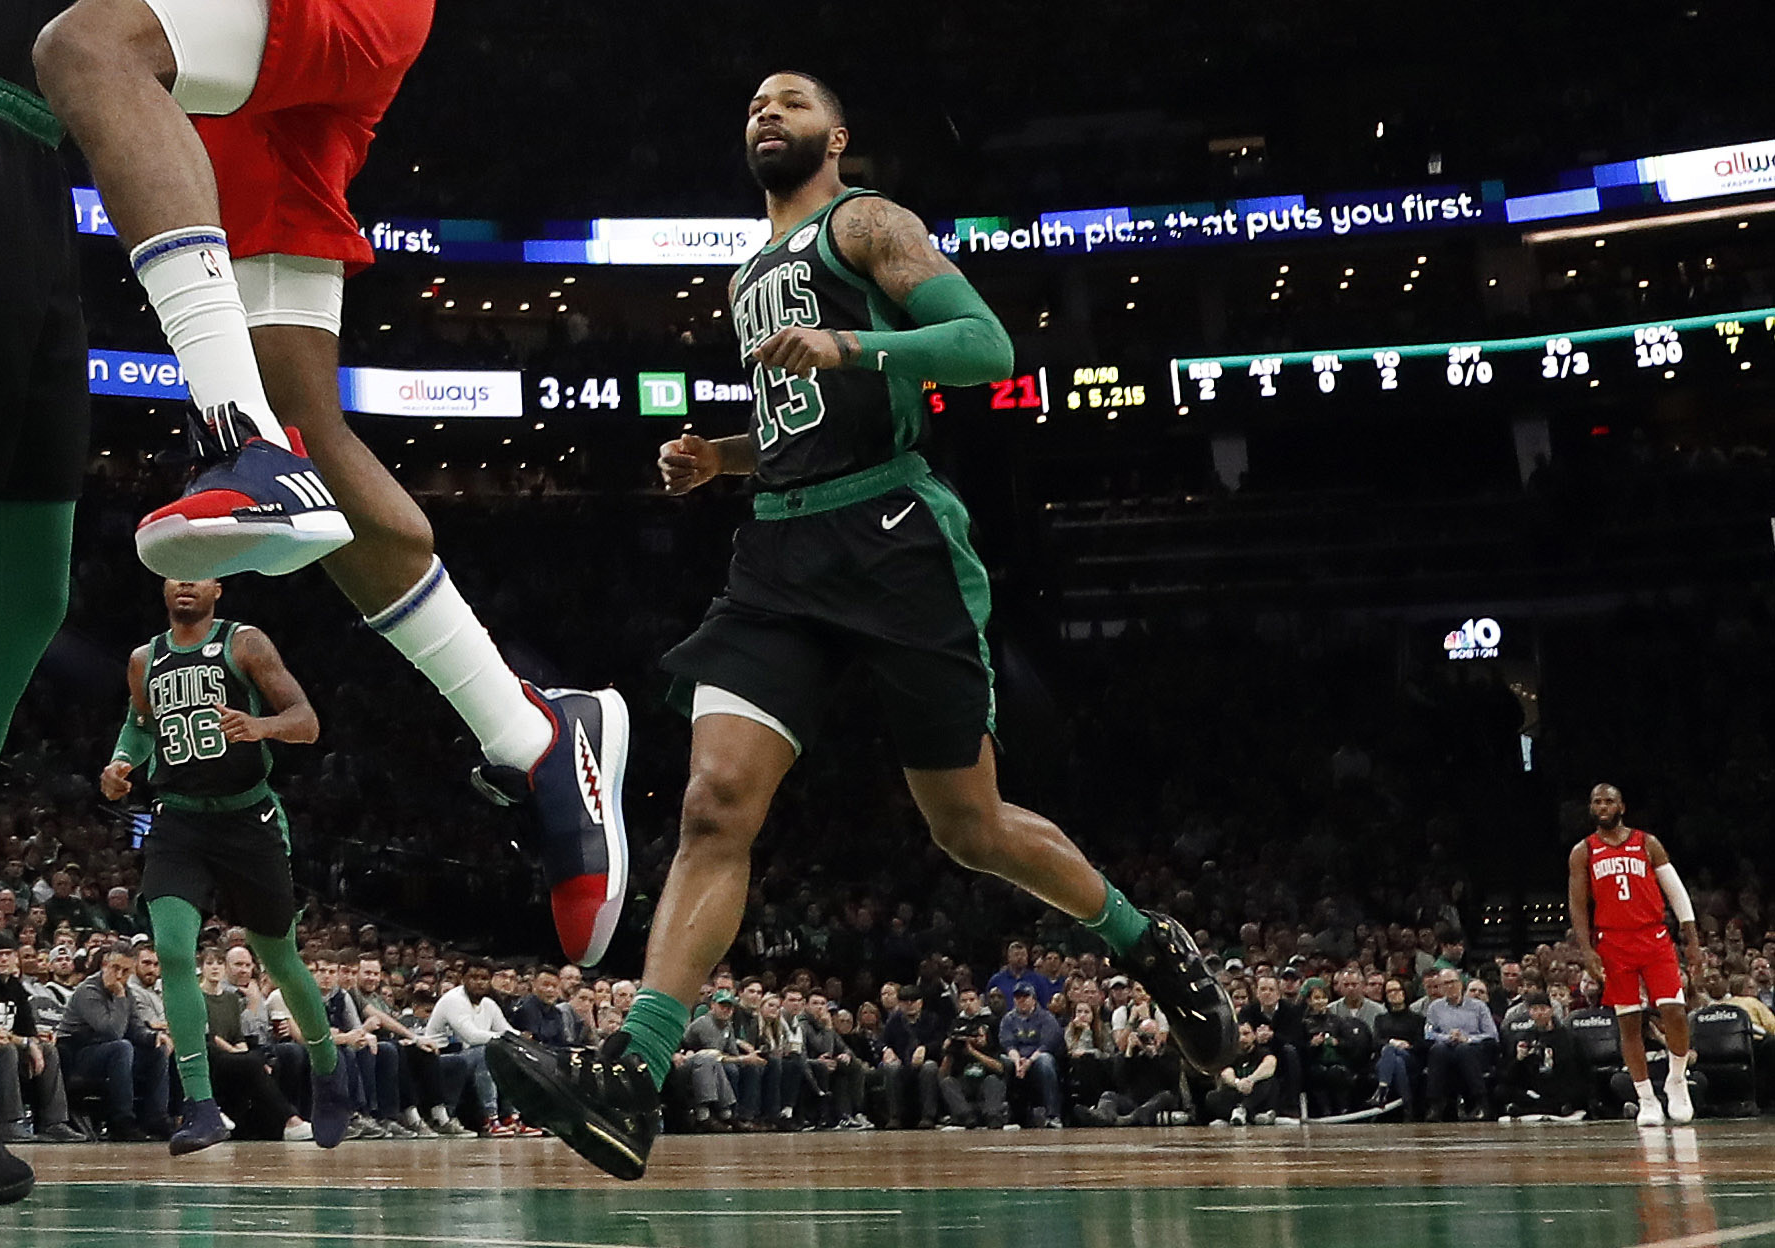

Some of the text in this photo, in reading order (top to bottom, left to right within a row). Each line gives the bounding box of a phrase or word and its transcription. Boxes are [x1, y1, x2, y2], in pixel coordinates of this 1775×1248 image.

[969, 219, 1075, 252] health
[1246, 203, 1323, 241] puts
[1331, 201, 1394, 235] you
[1401, 192, 1482, 223] first.
[652, 224, 748, 256] allways
[1635, 341, 1683, 368] 100
[1726, 336, 1740, 354] 7
[1248, 357, 1283, 377] AST
[1312, 354, 1343, 373] STL
[1373, 351, 1401, 369] TO
[1259, 375, 1277, 397] 1
[1318, 370, 1336, 394] 0
[1380, 367, 1398, 390] 2
[1446, 361, 1493, 387] 0/0
[398, 380, 489, 411] allways
[539, 376, 621, 410] 3:44
[643, 380, 682, 407] TD
[990, 374, 1041, 410] 21
[1199, 378, 1216, 401] 2
[753, 361, 826, 451] 13
[1462, 617, 1501, 648] 10
[1449, 647, 1498, 660] BOSTON
[149, 665, 227, 720] CELTICS
[160, 708, 227, 766] 36
[1593, 856, 1646, 881] HOUSTON
[1616, 874, 1631, 901] 3
